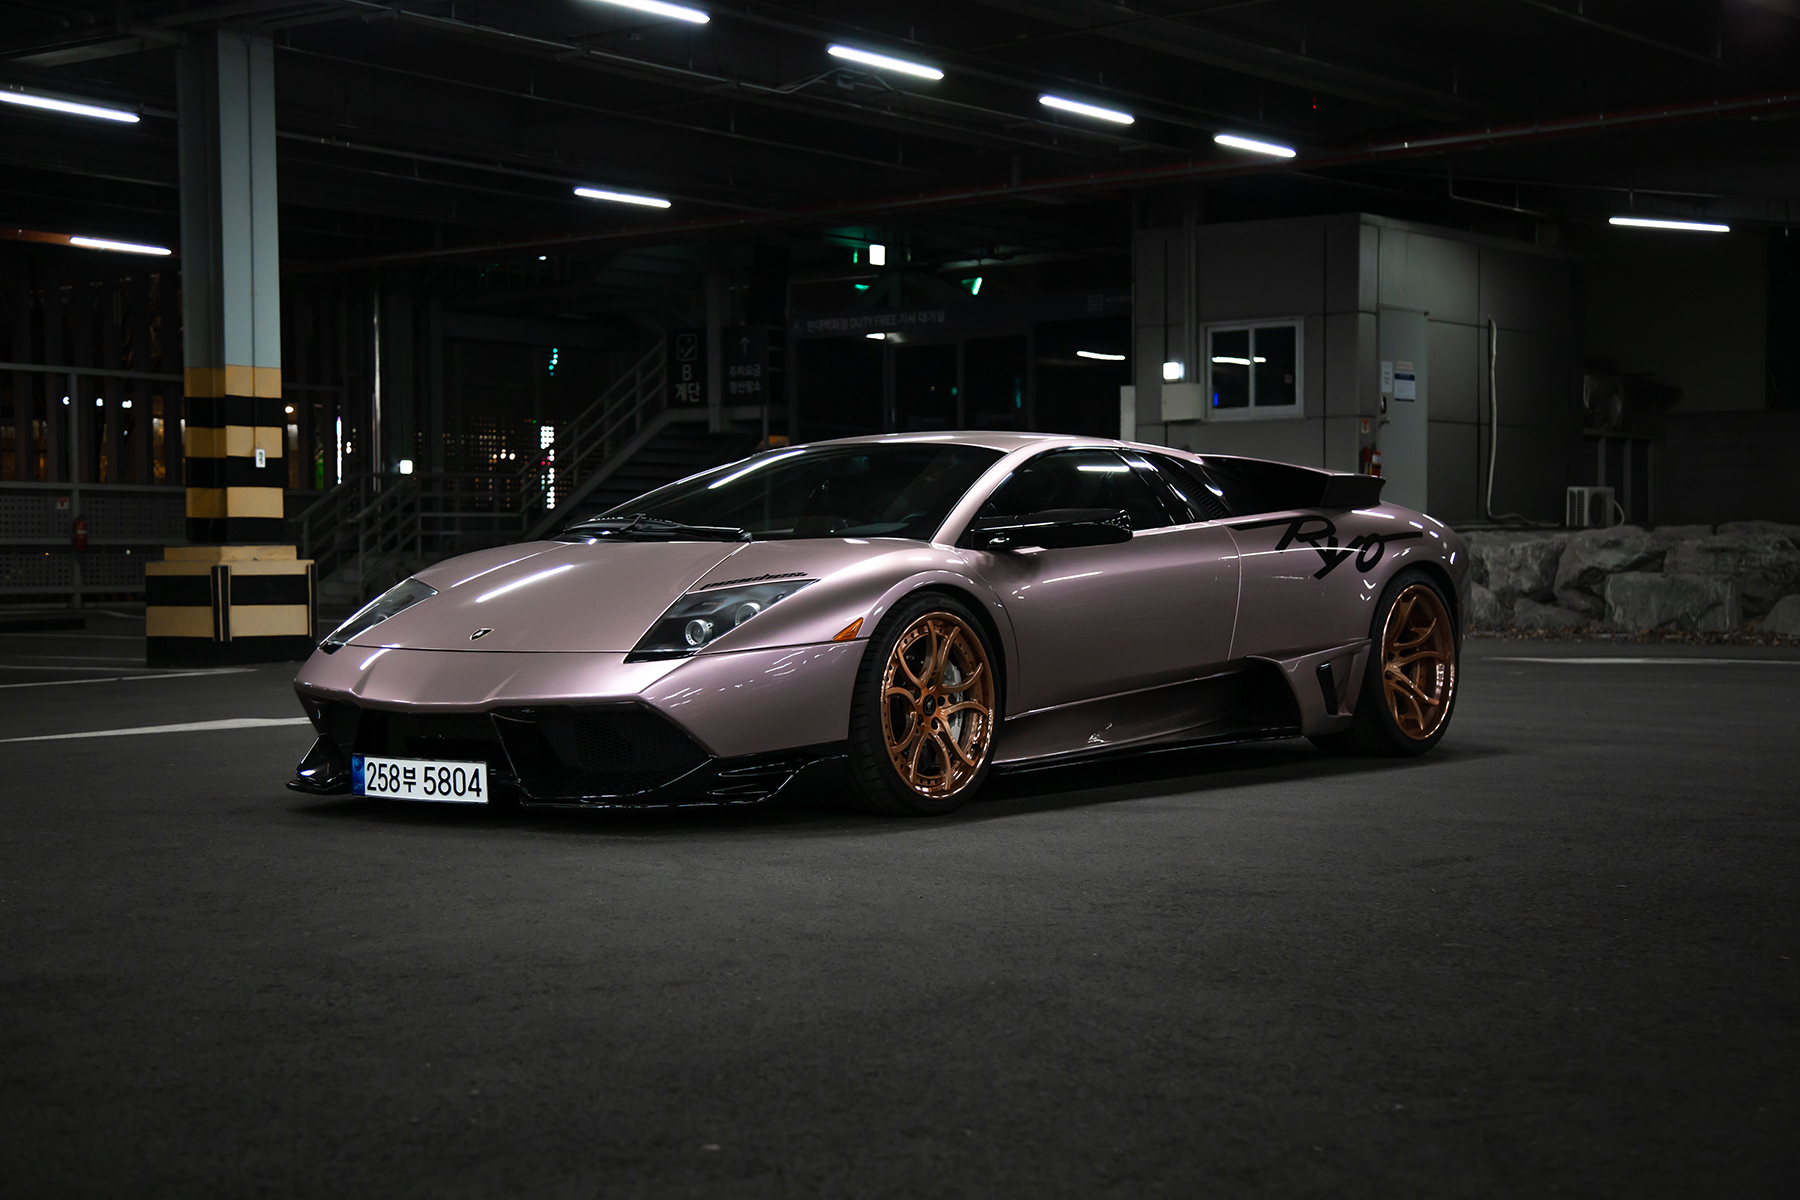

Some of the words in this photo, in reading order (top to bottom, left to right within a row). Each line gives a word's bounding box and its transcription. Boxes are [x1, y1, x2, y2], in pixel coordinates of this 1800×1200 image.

[850, 316, 874, 329] DUTY
[875, 313, 897, 327] FREE
[899, 312, 916, 326] 기사
[918, 310, 946, 323] 대기실
[681, 364, 692, 381] B
[675, 381, 701, 403] 계단
[366, 761, 417, 793] 258부
[423, 766, 482, 797] 5804
